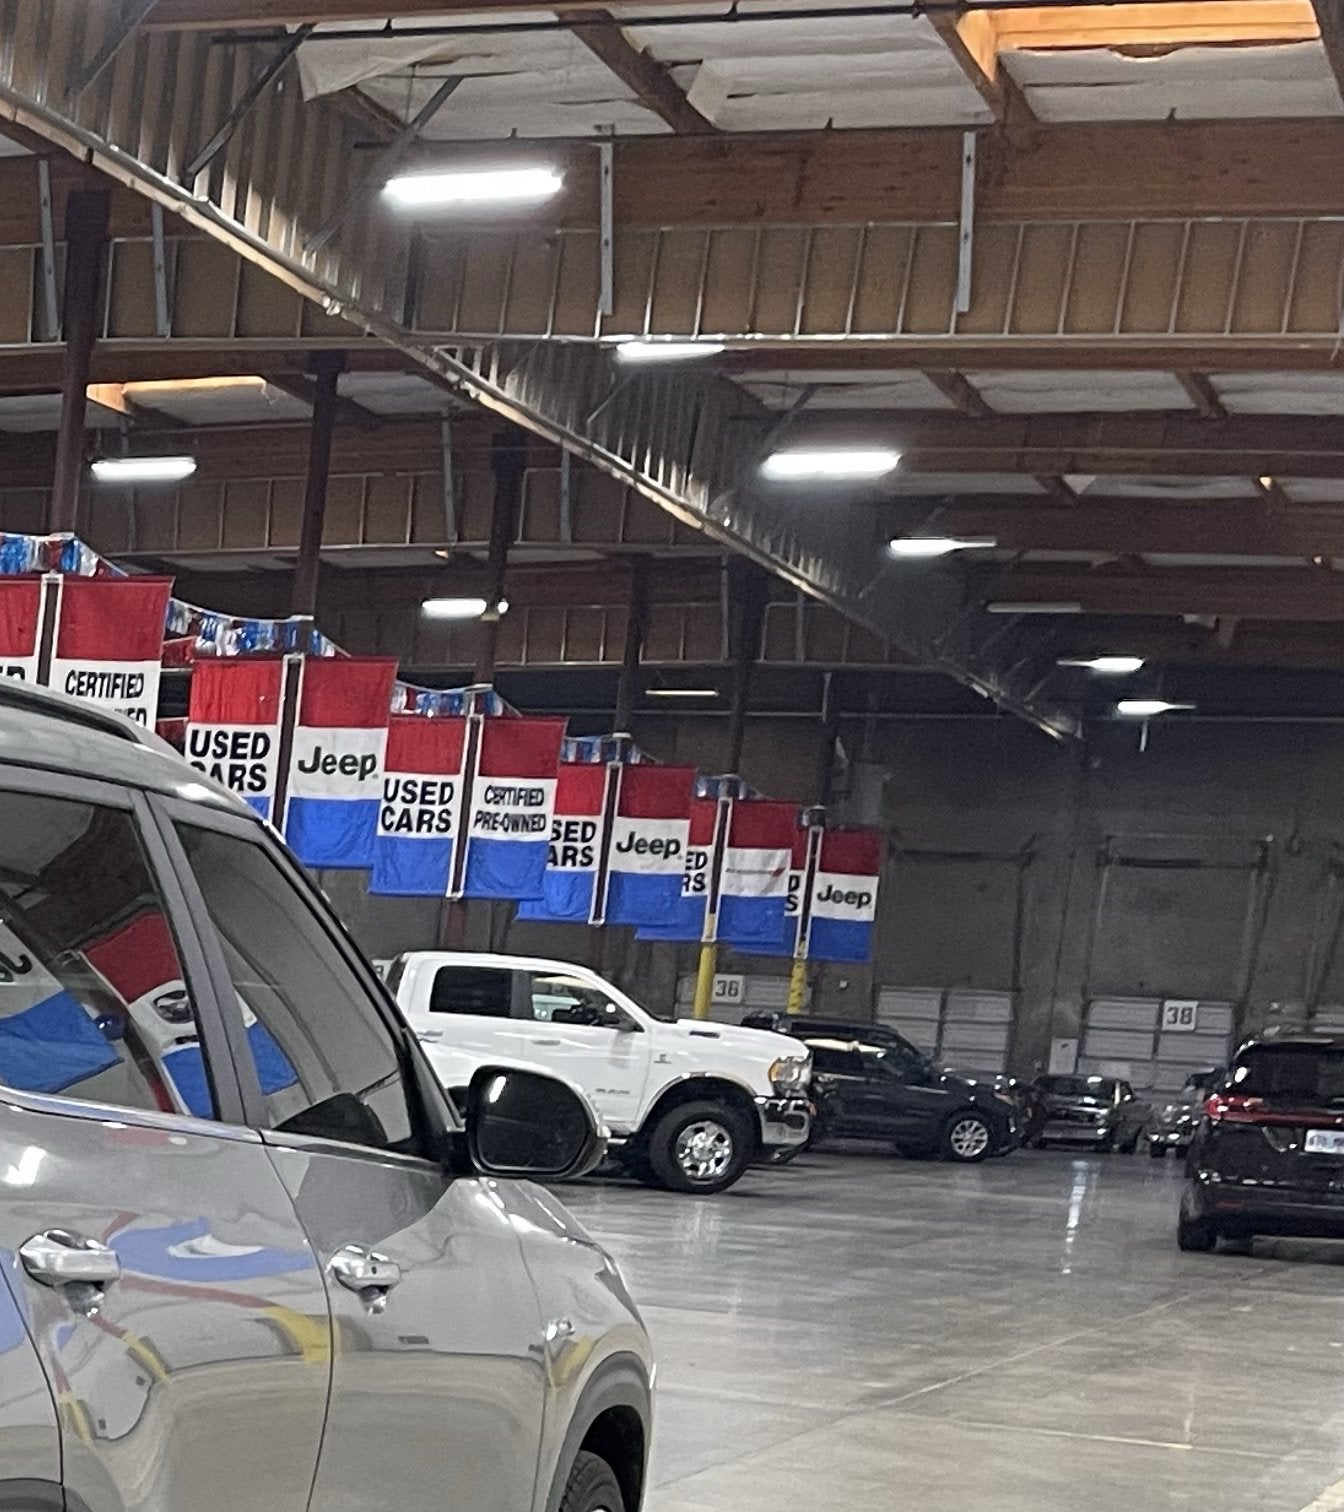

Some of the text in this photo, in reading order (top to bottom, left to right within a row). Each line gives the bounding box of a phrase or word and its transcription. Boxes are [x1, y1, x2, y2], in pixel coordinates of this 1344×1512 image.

[65, 669, 145, 699] CERTIFIED
[189, 729, 271, 760] USED
[297, 746, 377, 781] Jeep
[384, 778, 454, 806] USED
[484, 785, 545, 807] CERTIFIED
[381, 806, 453, 834] CARS
[473, 810, 546, 833] PRE-OWNED
[550, 820, 596, 843] SED
[547, 845, 594, 867] ARS
[616, 831, 681, 860] Jeep
[817, 884, 872, 909] Jeep
[1166, 1006, 1193, 1025] 38
